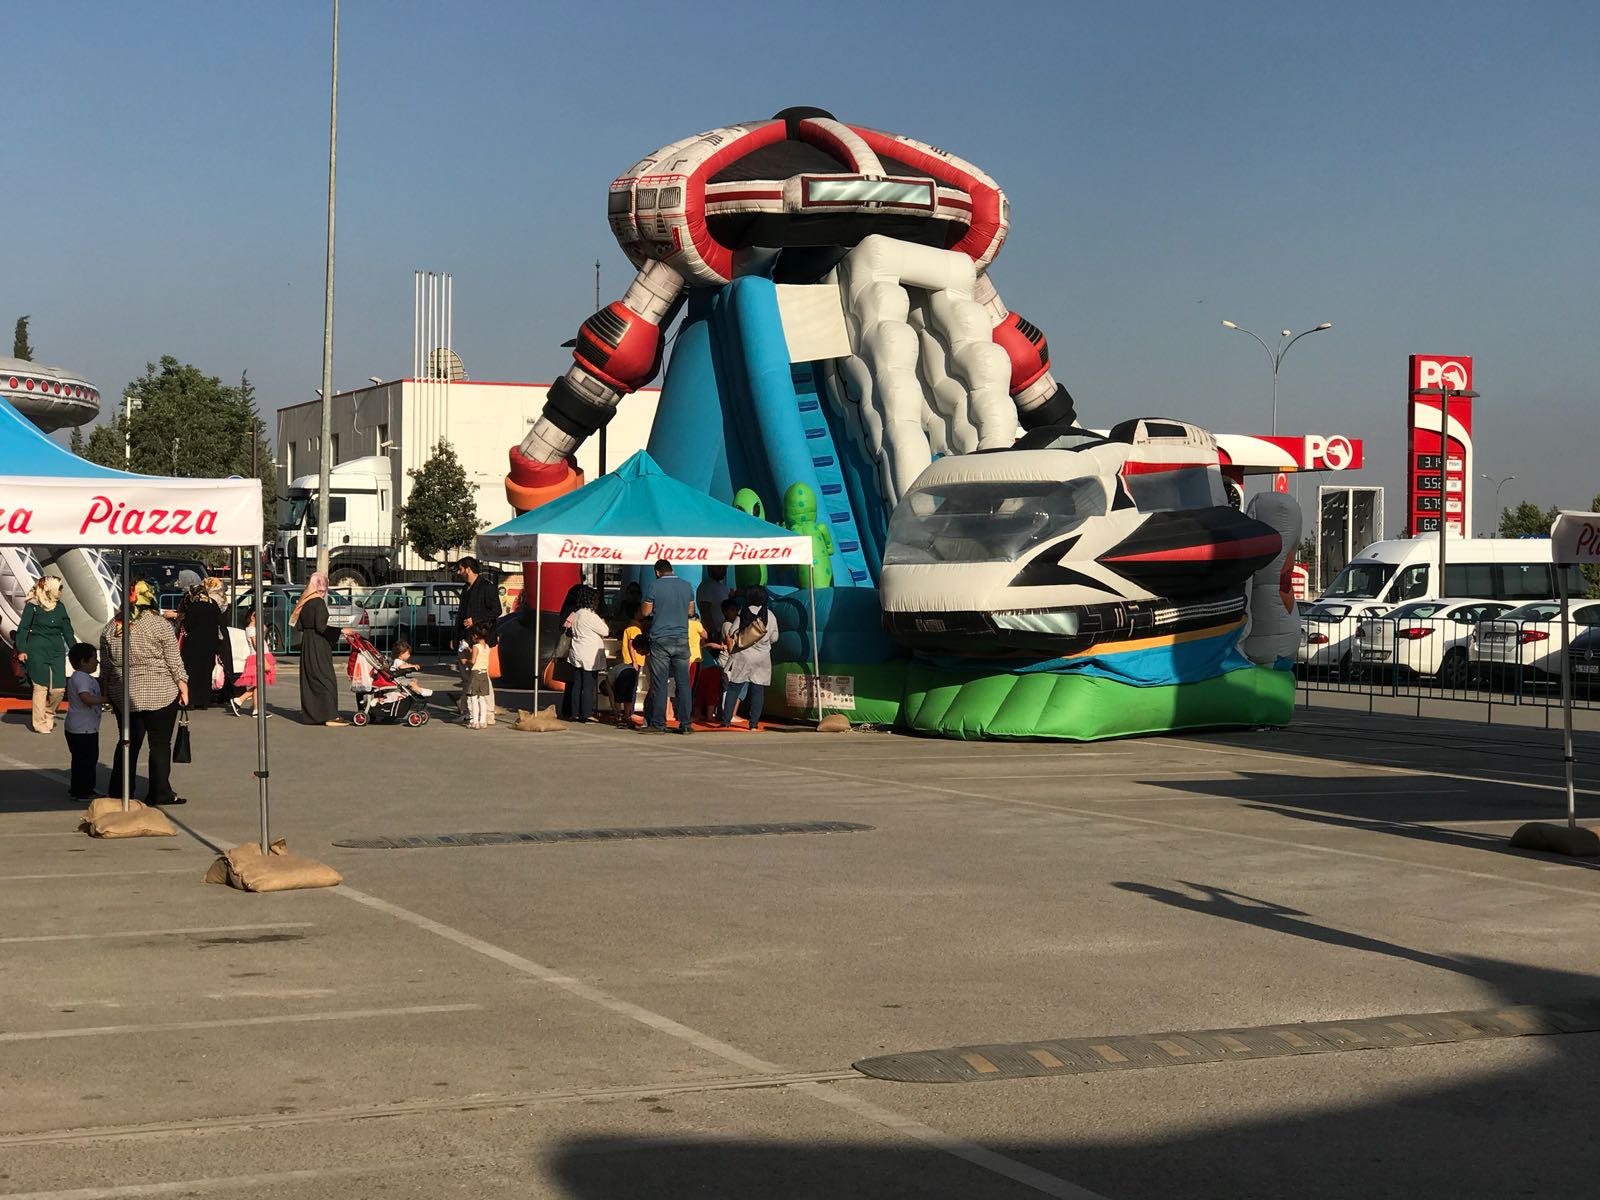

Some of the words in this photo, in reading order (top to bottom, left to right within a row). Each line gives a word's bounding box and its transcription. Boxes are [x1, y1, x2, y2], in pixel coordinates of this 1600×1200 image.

[0, 508, 33, 534] a
[79, 495, 219, 535] Piazza
[1423, 518, 1442, 531] 6.2
[559, 539, 622, 560] Piazza
[644, 542, 708, 560] Piazza
[1576, 523, 1600, 555] Pi
